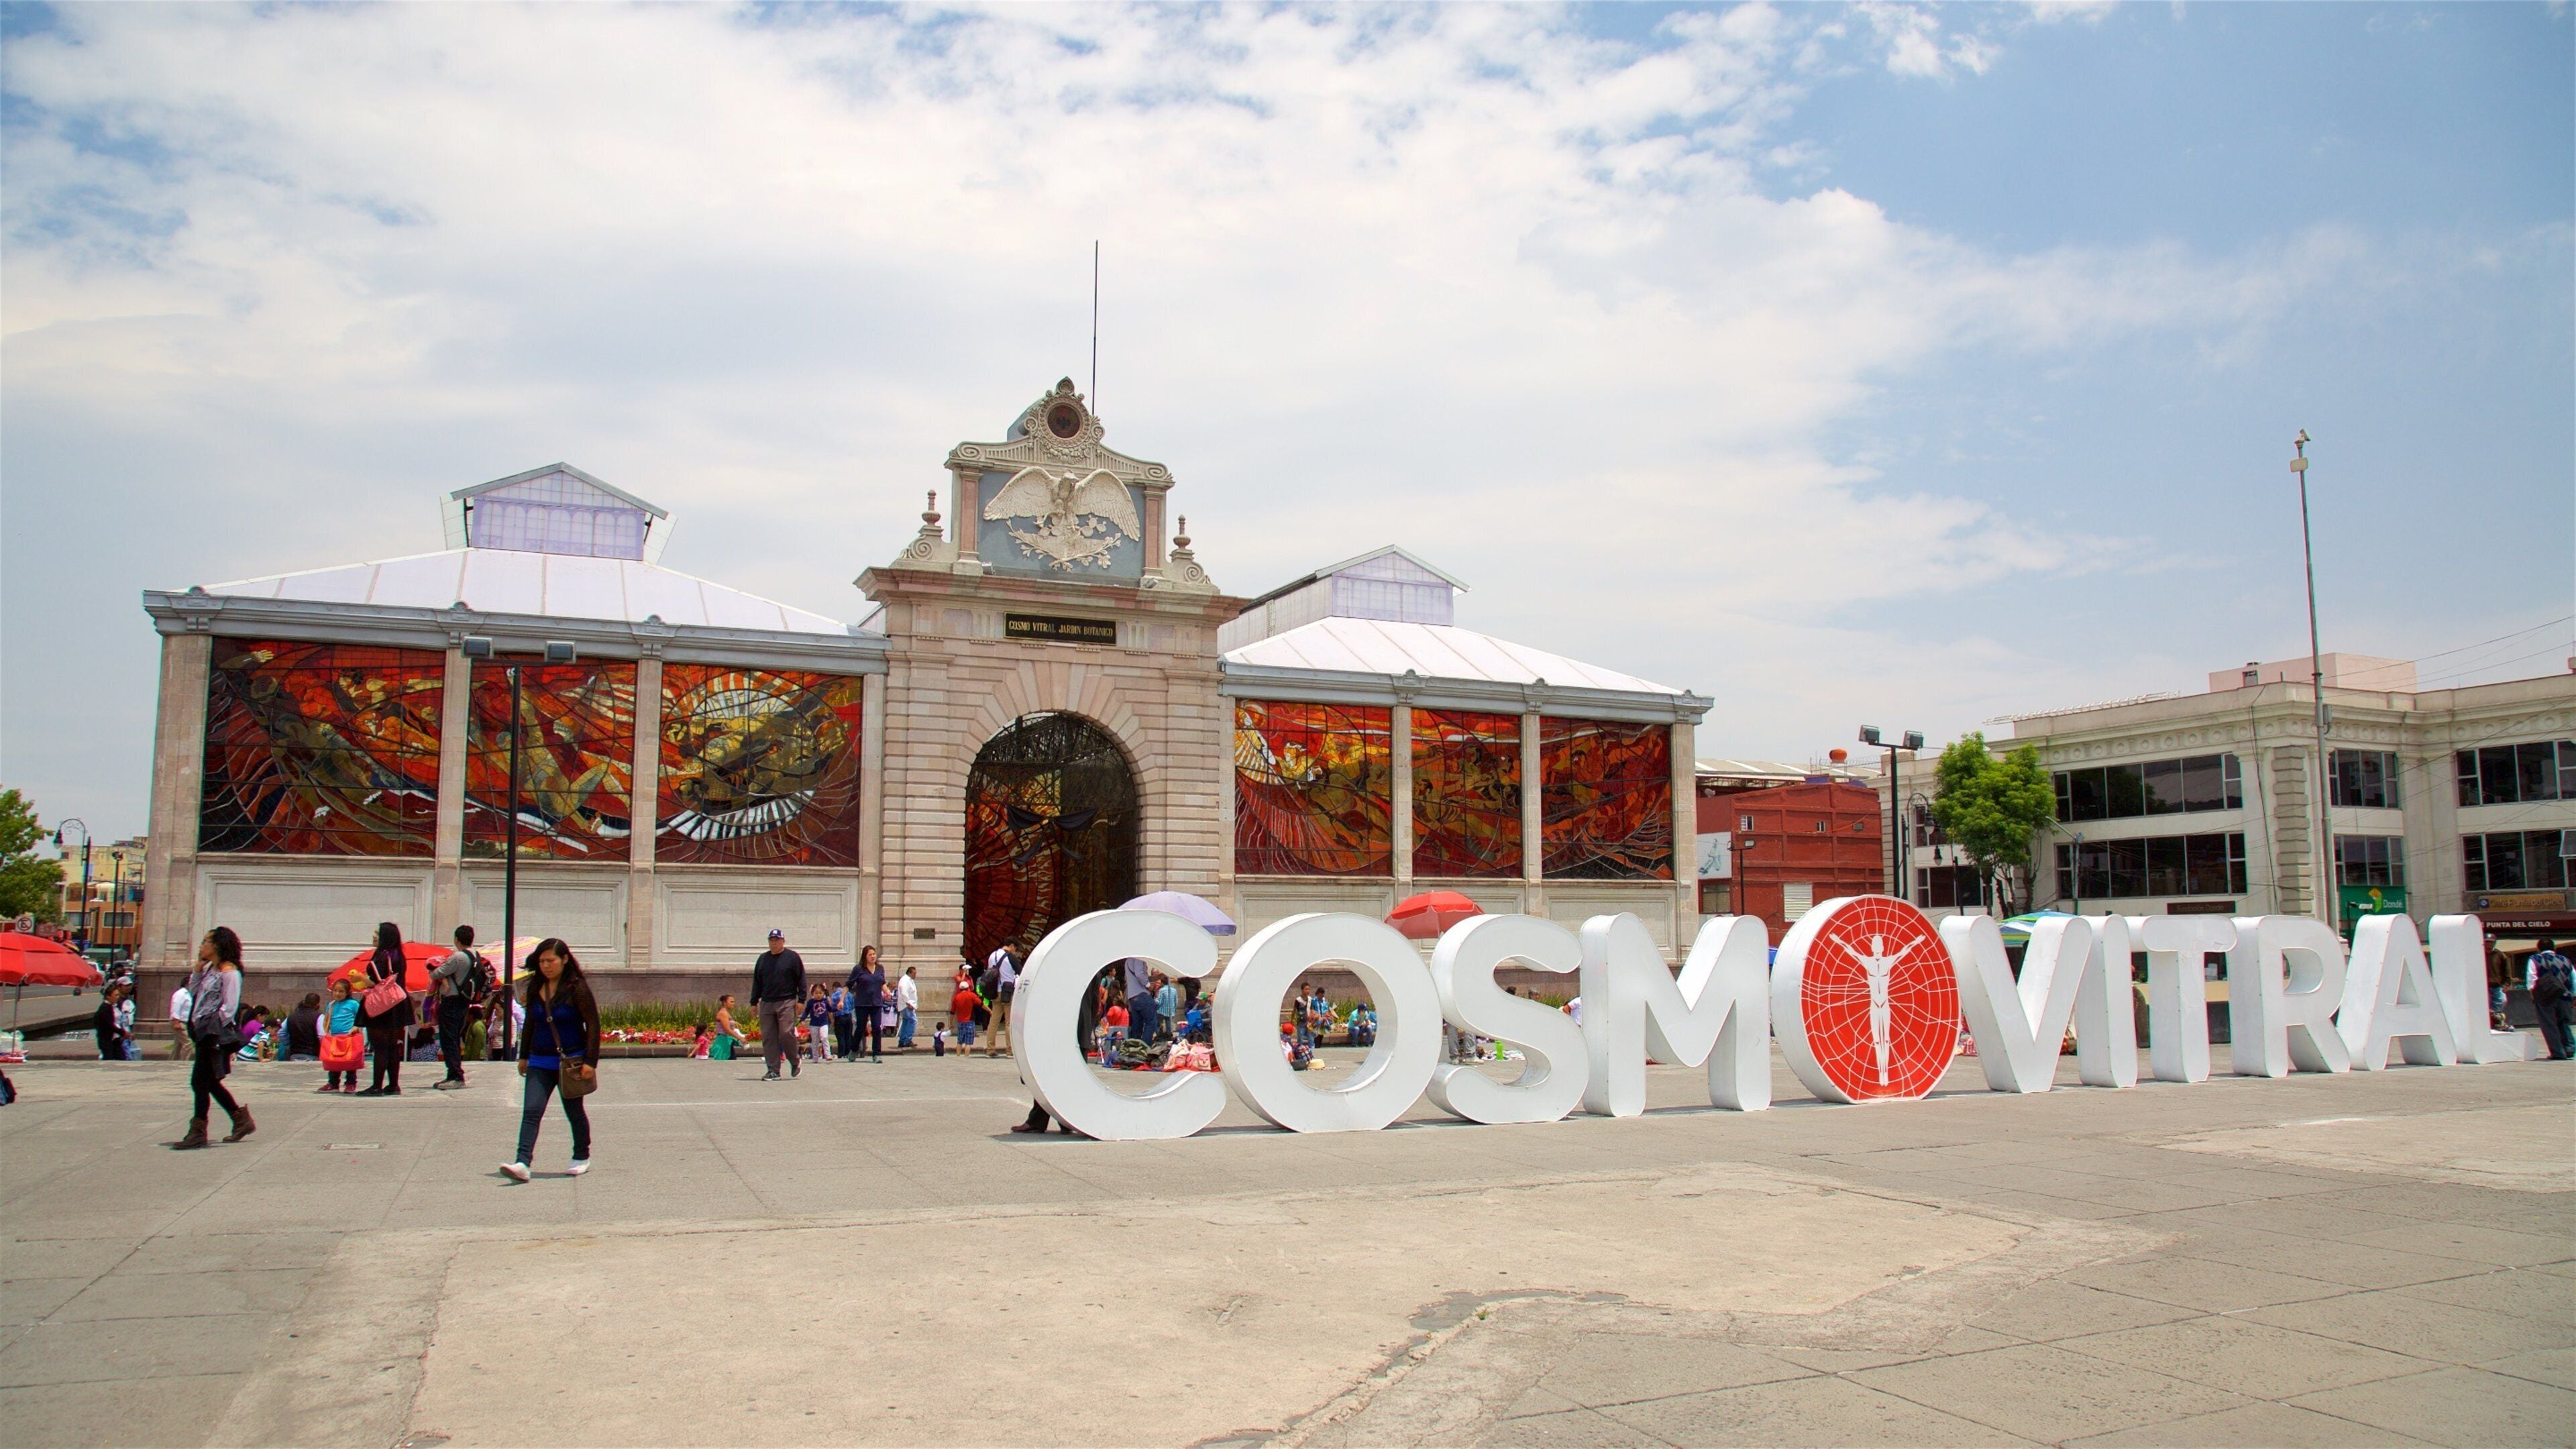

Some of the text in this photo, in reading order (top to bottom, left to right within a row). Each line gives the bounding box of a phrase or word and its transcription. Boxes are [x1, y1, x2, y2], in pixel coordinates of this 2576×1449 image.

[1008, 620, 1113, 637] COSMO VITRAL JARDIN BOTANICO
